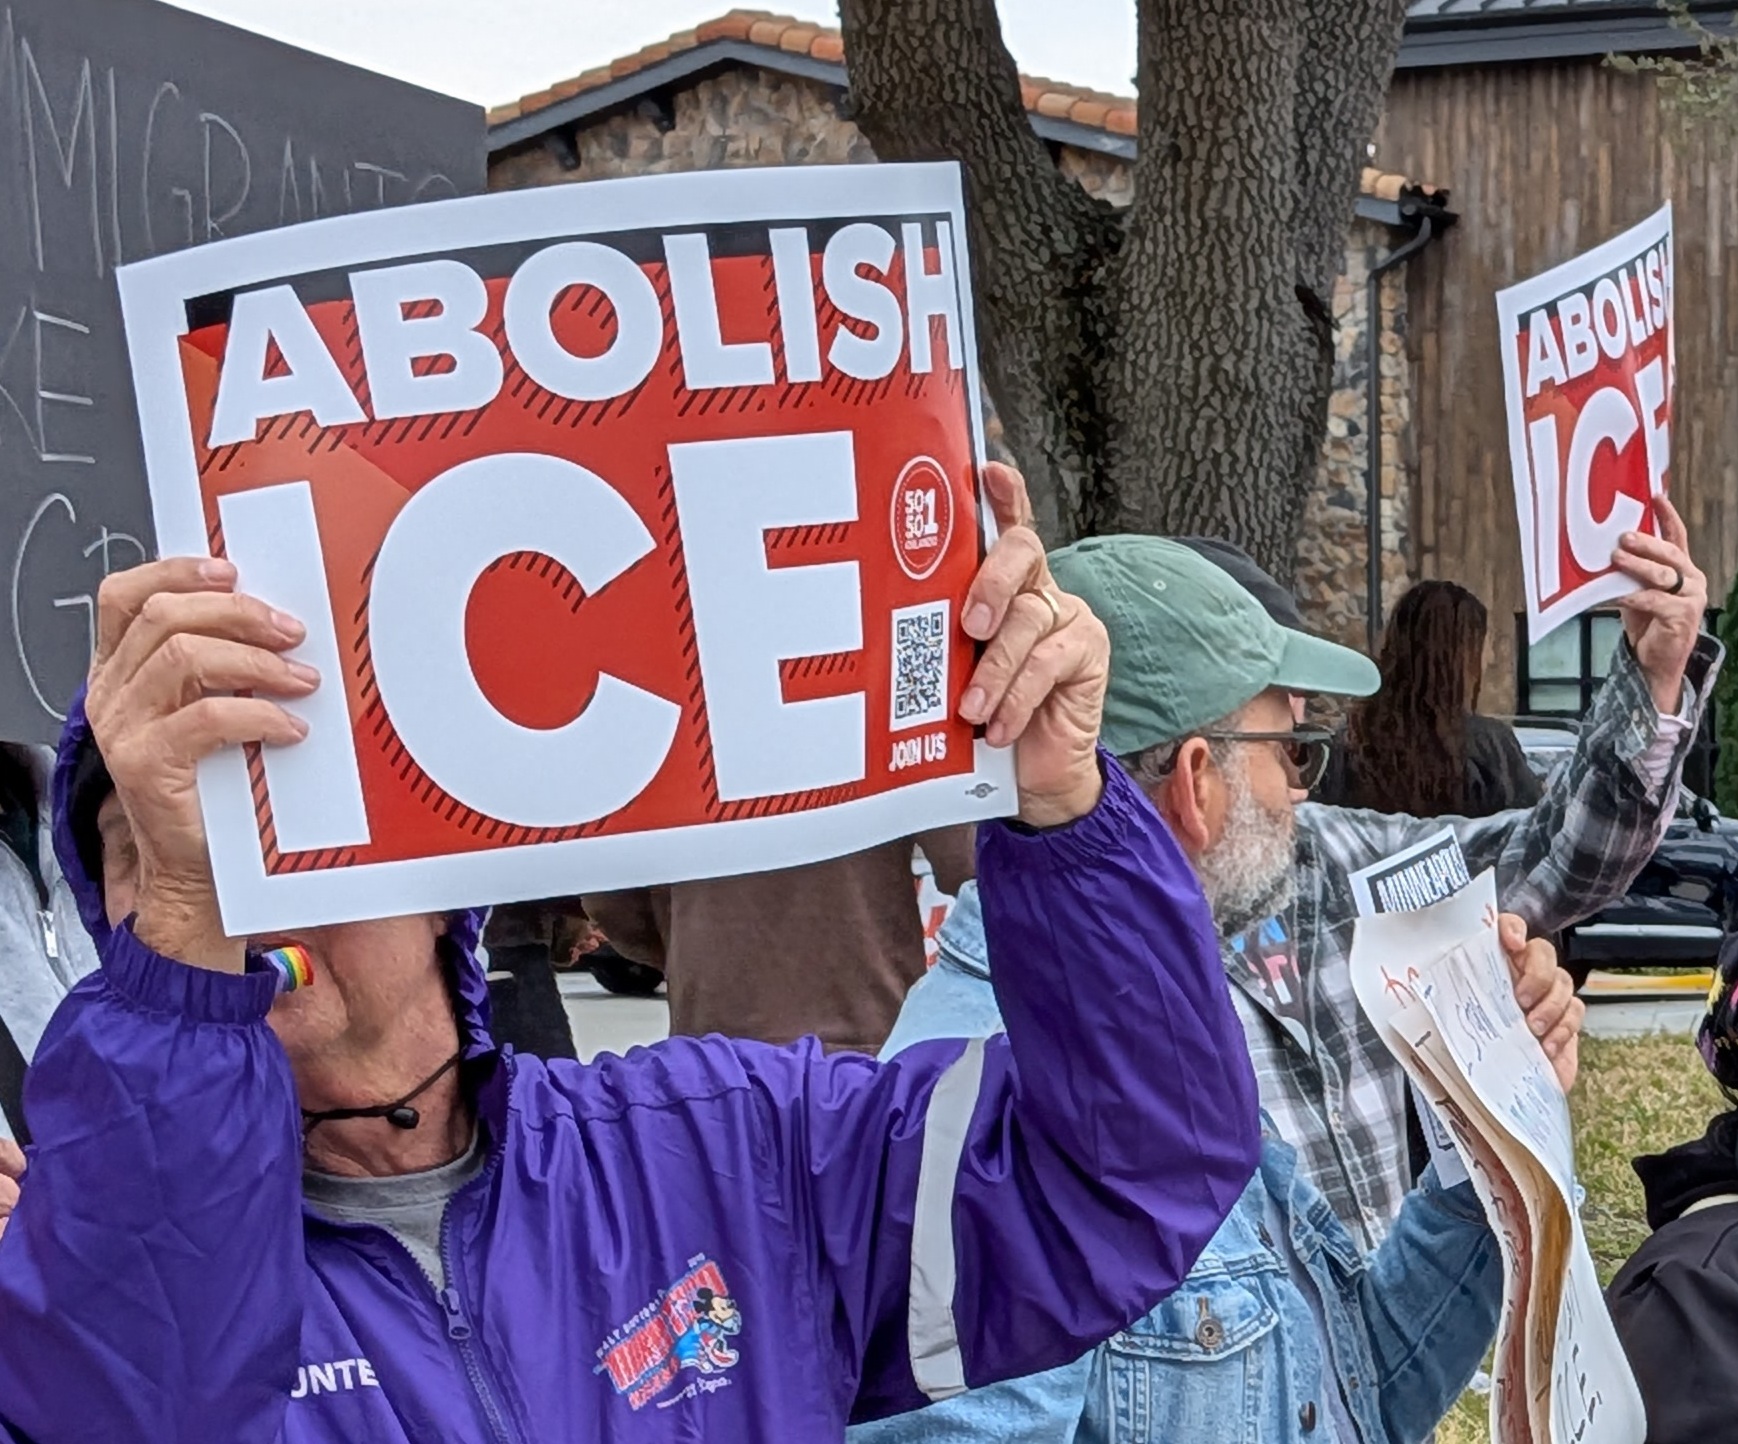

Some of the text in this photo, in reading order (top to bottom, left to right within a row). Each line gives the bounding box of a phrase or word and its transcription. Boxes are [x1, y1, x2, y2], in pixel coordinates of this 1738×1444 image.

[207, 221, 964, 449] ABOLISH
[216, 430, 867, 855] ICE
[888, 731, 947, 772] JOIN US
